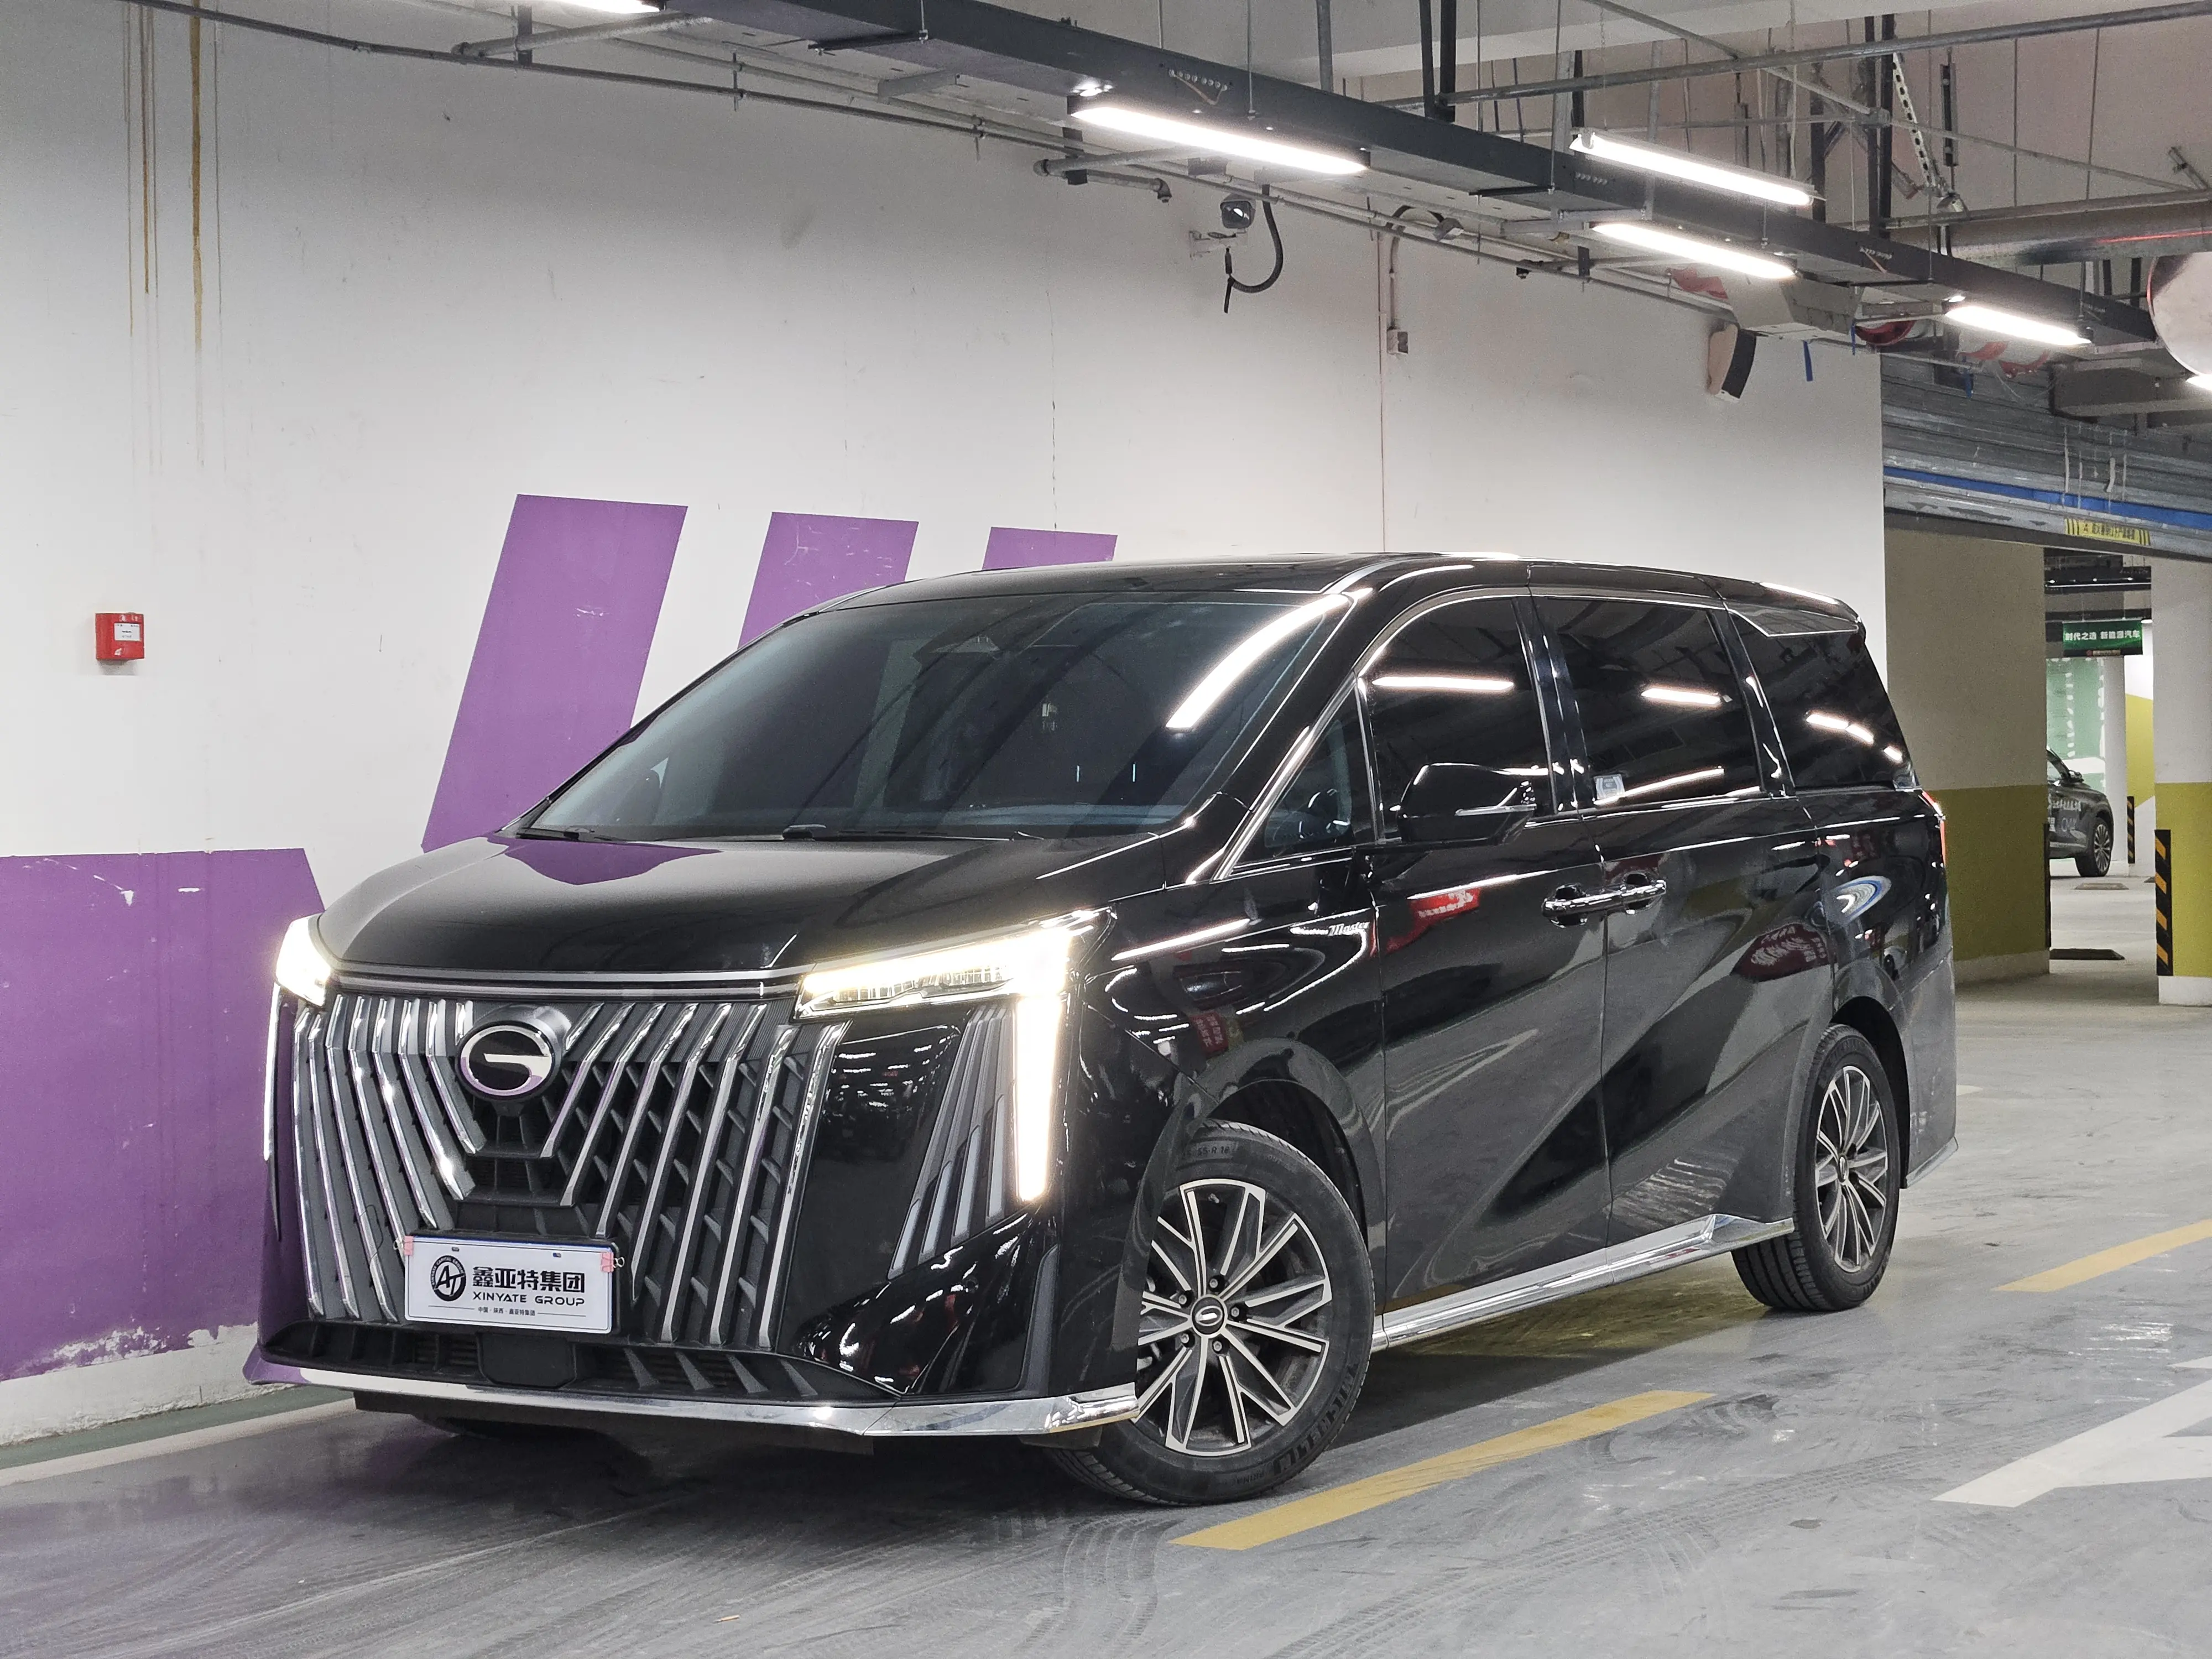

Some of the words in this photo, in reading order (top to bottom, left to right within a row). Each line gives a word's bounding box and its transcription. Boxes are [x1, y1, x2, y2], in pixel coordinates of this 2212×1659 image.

[473, 1266, 585, 1293] 鑫亚特集团
[473, 1292, 527, 1303] XINYATE
[535, 1295, 585, 1306] GROUP
